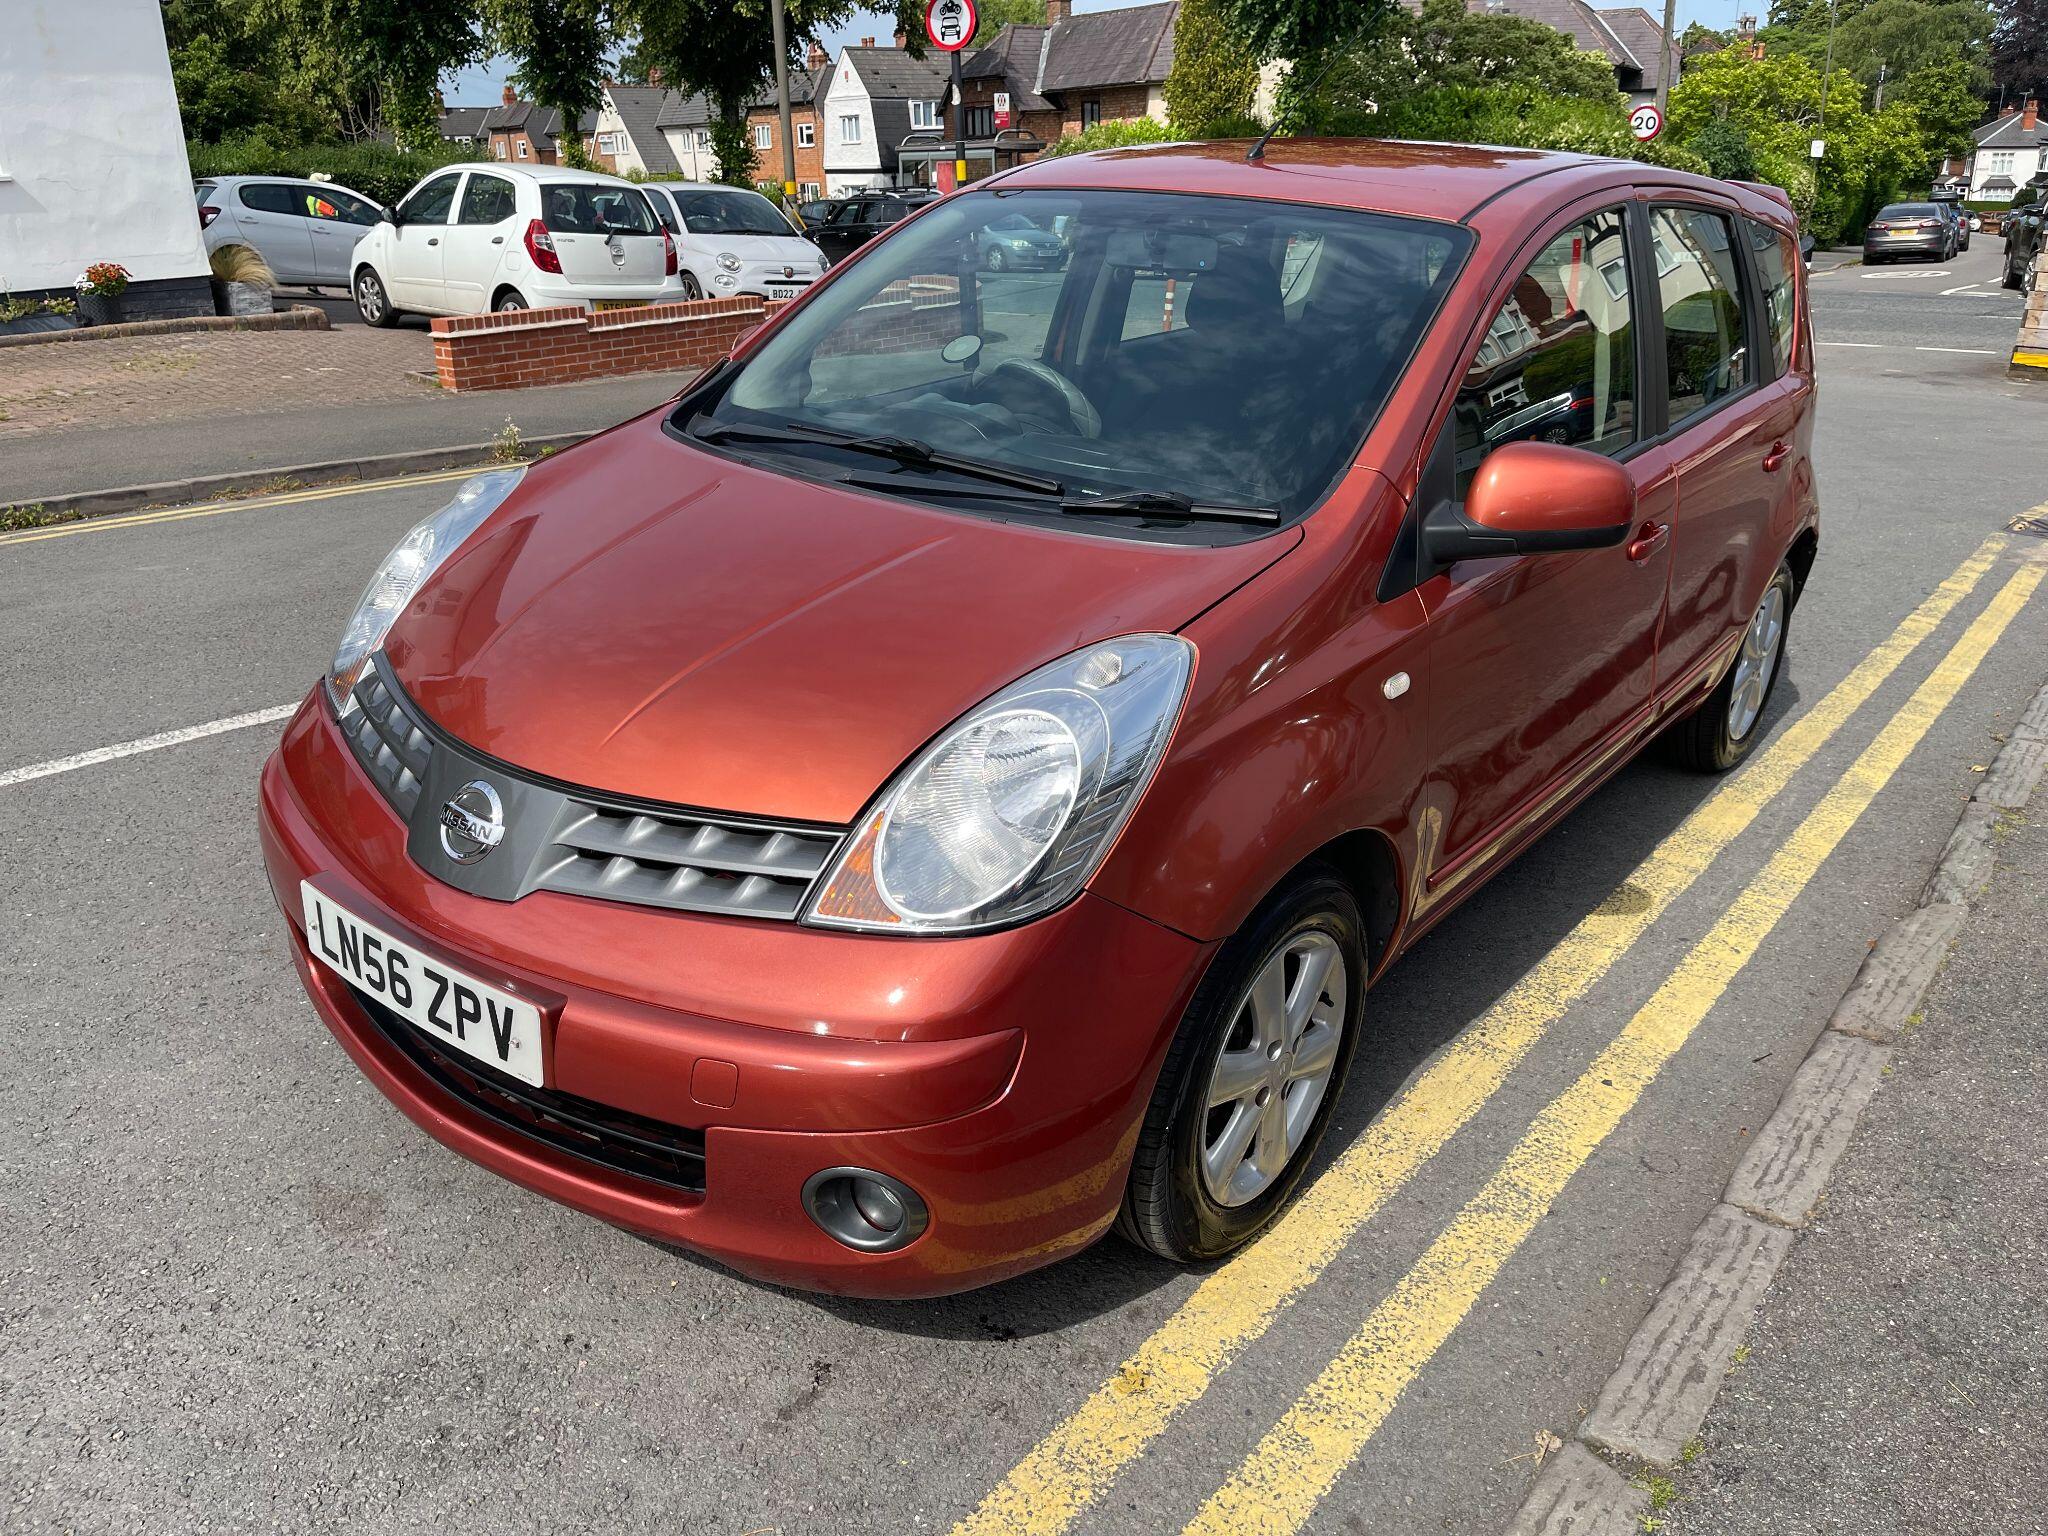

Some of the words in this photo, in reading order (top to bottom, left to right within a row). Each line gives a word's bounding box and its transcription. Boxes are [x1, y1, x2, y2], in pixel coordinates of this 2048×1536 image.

[1634, 116, 1657, 130] 20
[772, 289, 794, 299] BD22
[440, 805, 493, 840] NISSAN
[315, 900, 413, 1009] LN56
[423, 966, 514, 1062] ZPV
